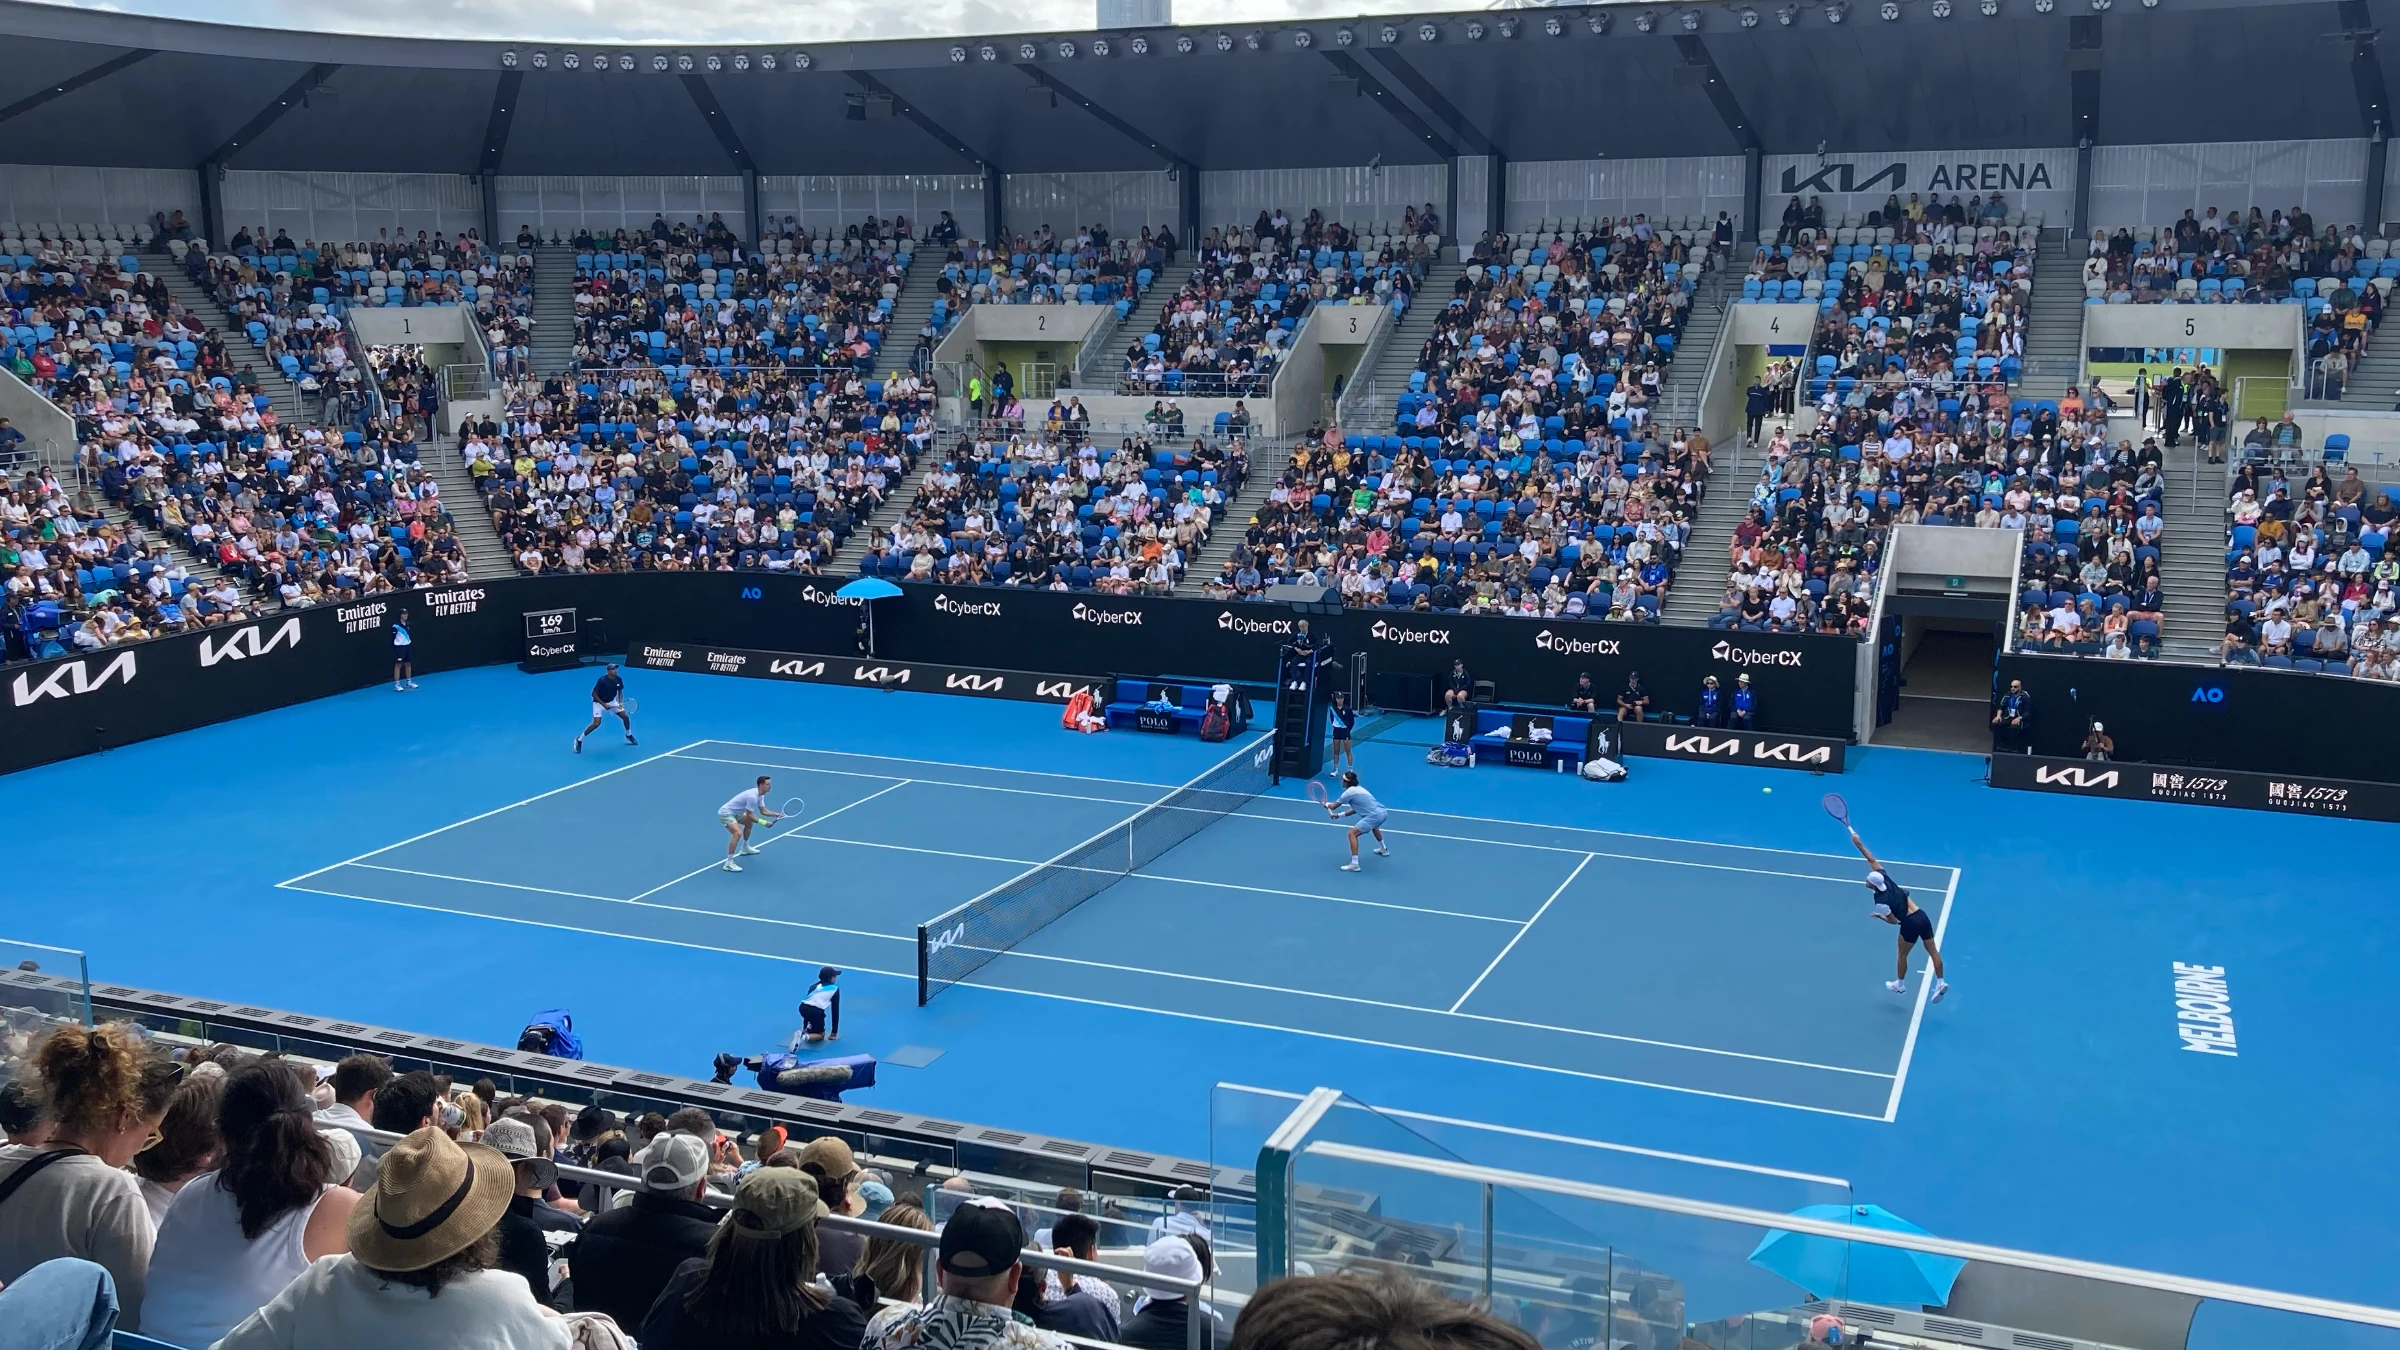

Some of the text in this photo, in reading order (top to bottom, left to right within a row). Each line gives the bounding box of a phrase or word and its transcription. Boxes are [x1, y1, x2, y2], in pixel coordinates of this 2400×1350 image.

[1781, 162, 2052, 193] KIA ARENA
[404, 319, 411, 334] 1
[1038, 315, 1045, 331] 2
[1349, 317, 1357, 333] 3
[1770, 317, 1780, 334] 4
[2185, 318, 2195, 336] 5
[425, 588, 486, 606] Emirates
[741, 587, 762, 599] AO
[337, 602, 387, 622] Emirates
[435, 601, 477, 617] FLY BETTER
[949, 601, 1001, 617] CyberCX
[1087, 609, 1143, 626] CyberCX
[346, 616, 381, 634] FLY BETTER
[540, 614, 563, 627] 169
[1234, 617, 1292, 635] CyberCX
[543, 626, 561, 634] km/h
[1388, 627, 1450, 645] CyberCX
[200, 617, 301, 667] KIA
[540, 644, 575, 657] CyberCX
[1554, 637, 1620, 655] CyberCX
[643, 646, 682, 659] Emirates
[707, 652, 747, 665] Emirates
[1731, 648, 1802, 667] CyberCX
[646, 657, 675, 667] FLY BETTER
[710, 662, 739, 673] FLY BETTER
[770, 658, 825, 677] KIA
[13, 651, 136, 707] KIA
[854, 665, 911, 684] KIA
[945, 673, 1004, 692] KIA
[2191, 687, 2224, 703] AO
[1140, 716, 1168, 727] POLO
[1665, 733, 1740, 756] KIA
[1753, 741, 1831, 764] KIA
[1510, 749, 1542, 761] POLO
[2035, 765, 2119, 789] KIA
[2151, 788, 2226, 801] GUOJIAO 1573
[2268, 798, 2347, 812] GUOJIAO 1573
[2172, 961, 2238, 1057] MELBOURNE
